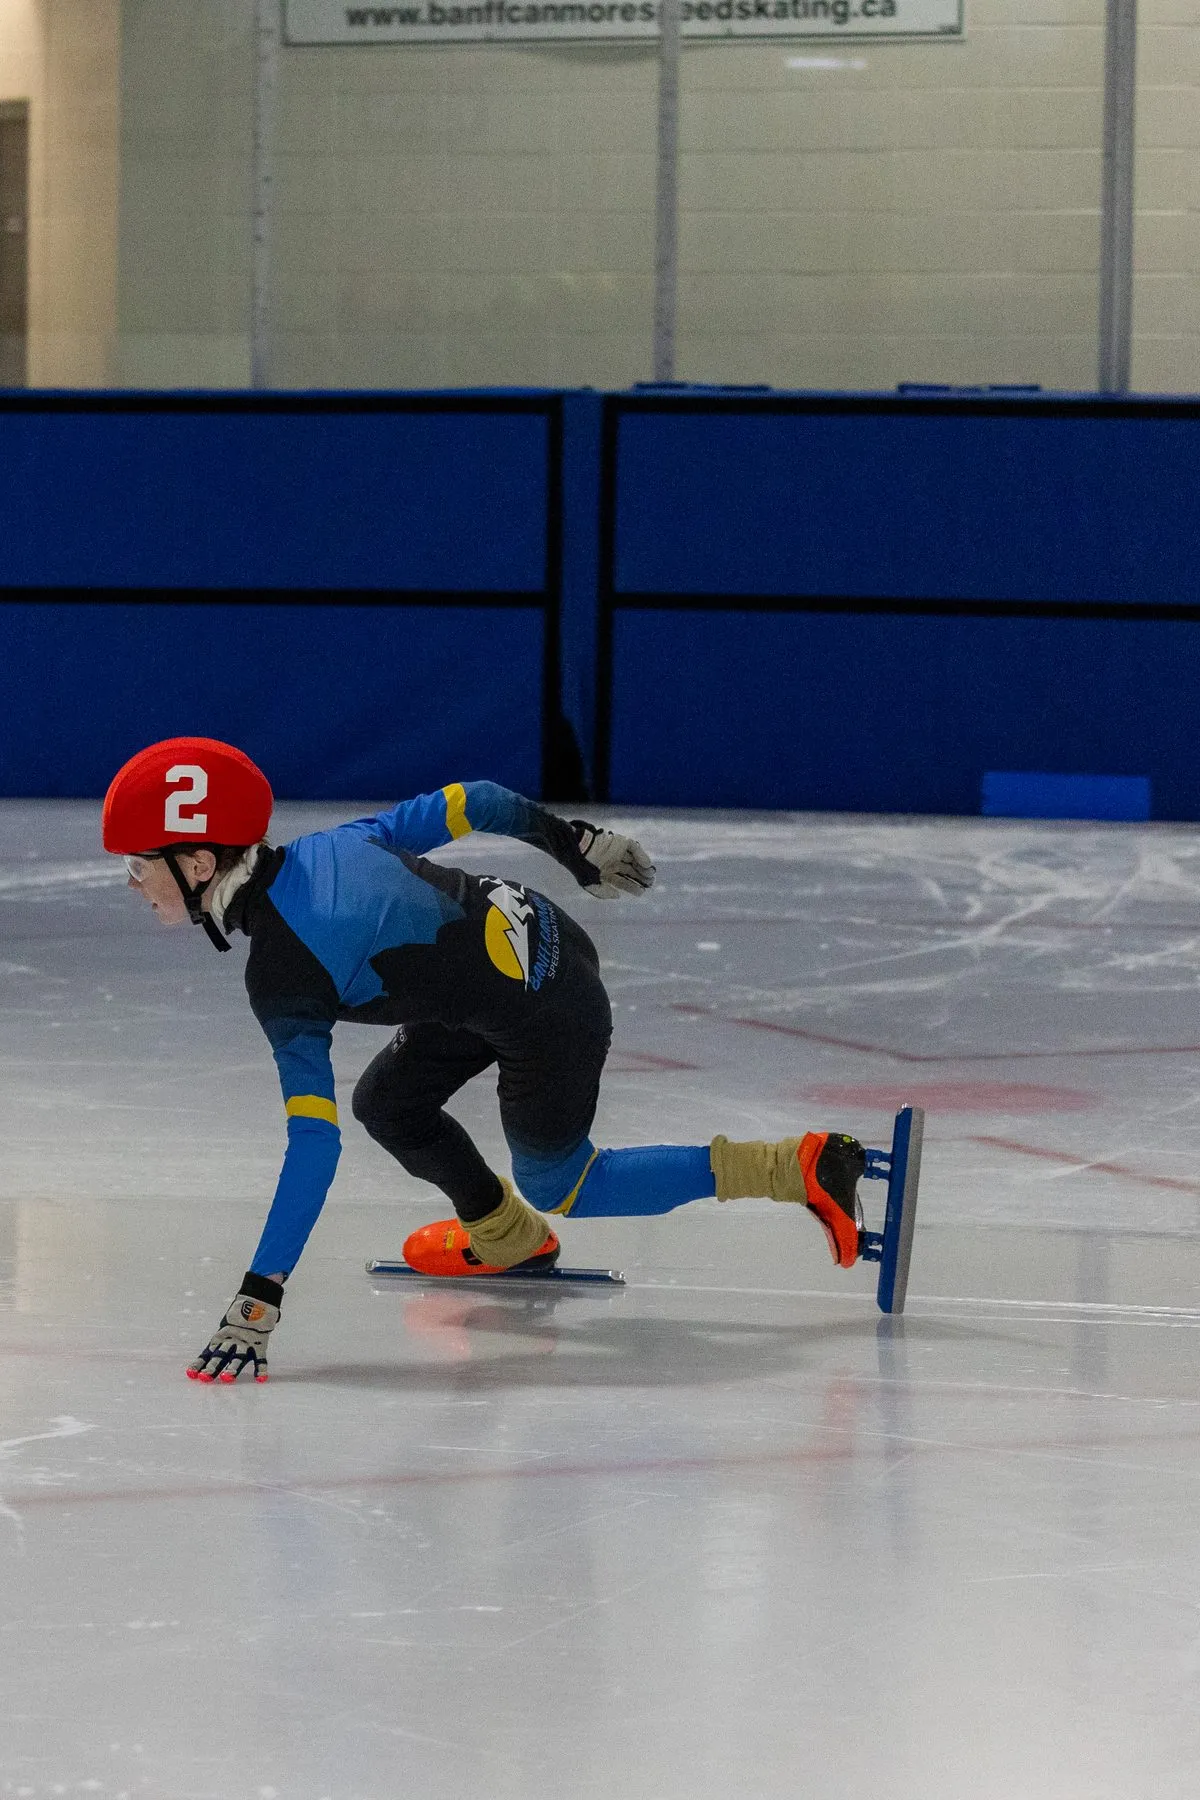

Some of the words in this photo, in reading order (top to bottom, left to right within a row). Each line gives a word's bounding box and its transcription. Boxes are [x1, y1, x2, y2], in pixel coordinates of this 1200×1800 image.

[346, 0, 898, 26] www.banffcanmoreseedskating.ca
[164, 764, 209, 834] 2
[547, 945, 560, 980] SPEED
